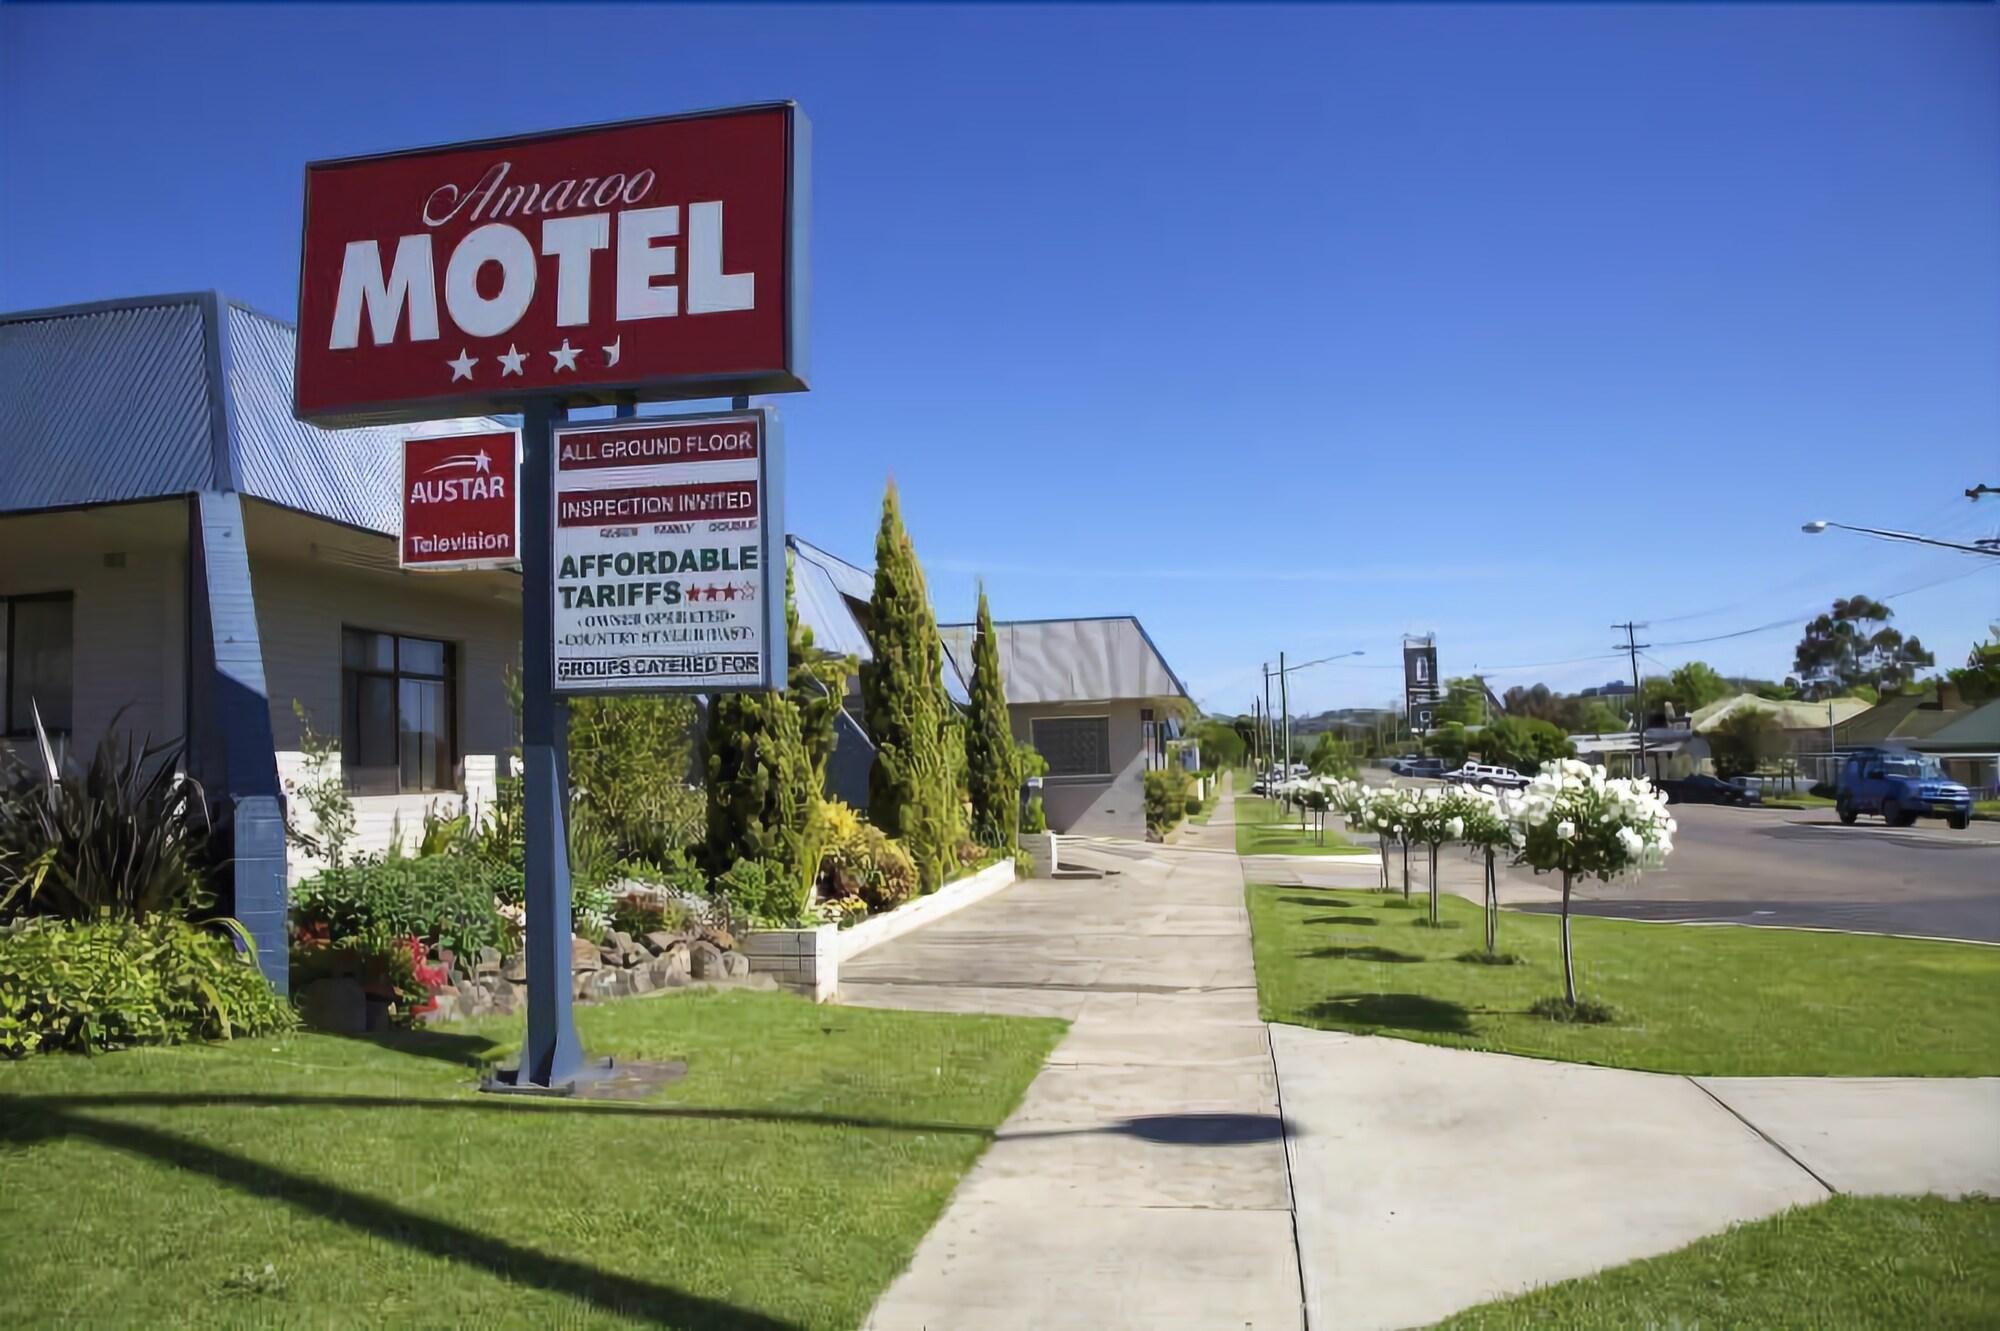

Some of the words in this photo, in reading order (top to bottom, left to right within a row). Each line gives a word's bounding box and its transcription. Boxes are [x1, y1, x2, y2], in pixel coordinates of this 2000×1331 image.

[423, 162, 656, 227] Amaroo
[329, 200, 755, 351] MOTEL
[561, 443, 596, 461] ALL
[601, 436, 681, 458] GROUND
[686, 432, 753, 452] FLOOR
[410, 476, 505, 504] AUSTAR
[562, 497, 673, 519] INSPECTION
[679, 491, 752, 512] INVITED
[410, 531, 509, 555] Television
[559, 545, 758, 579] AFFORDABLE
[558, 581, 681, 609] TARIFFS
[558, 660, 630, 676] GROUPS
[635, 656, 716, 674] CATERED
[722, 655, 759, 672] FOR
